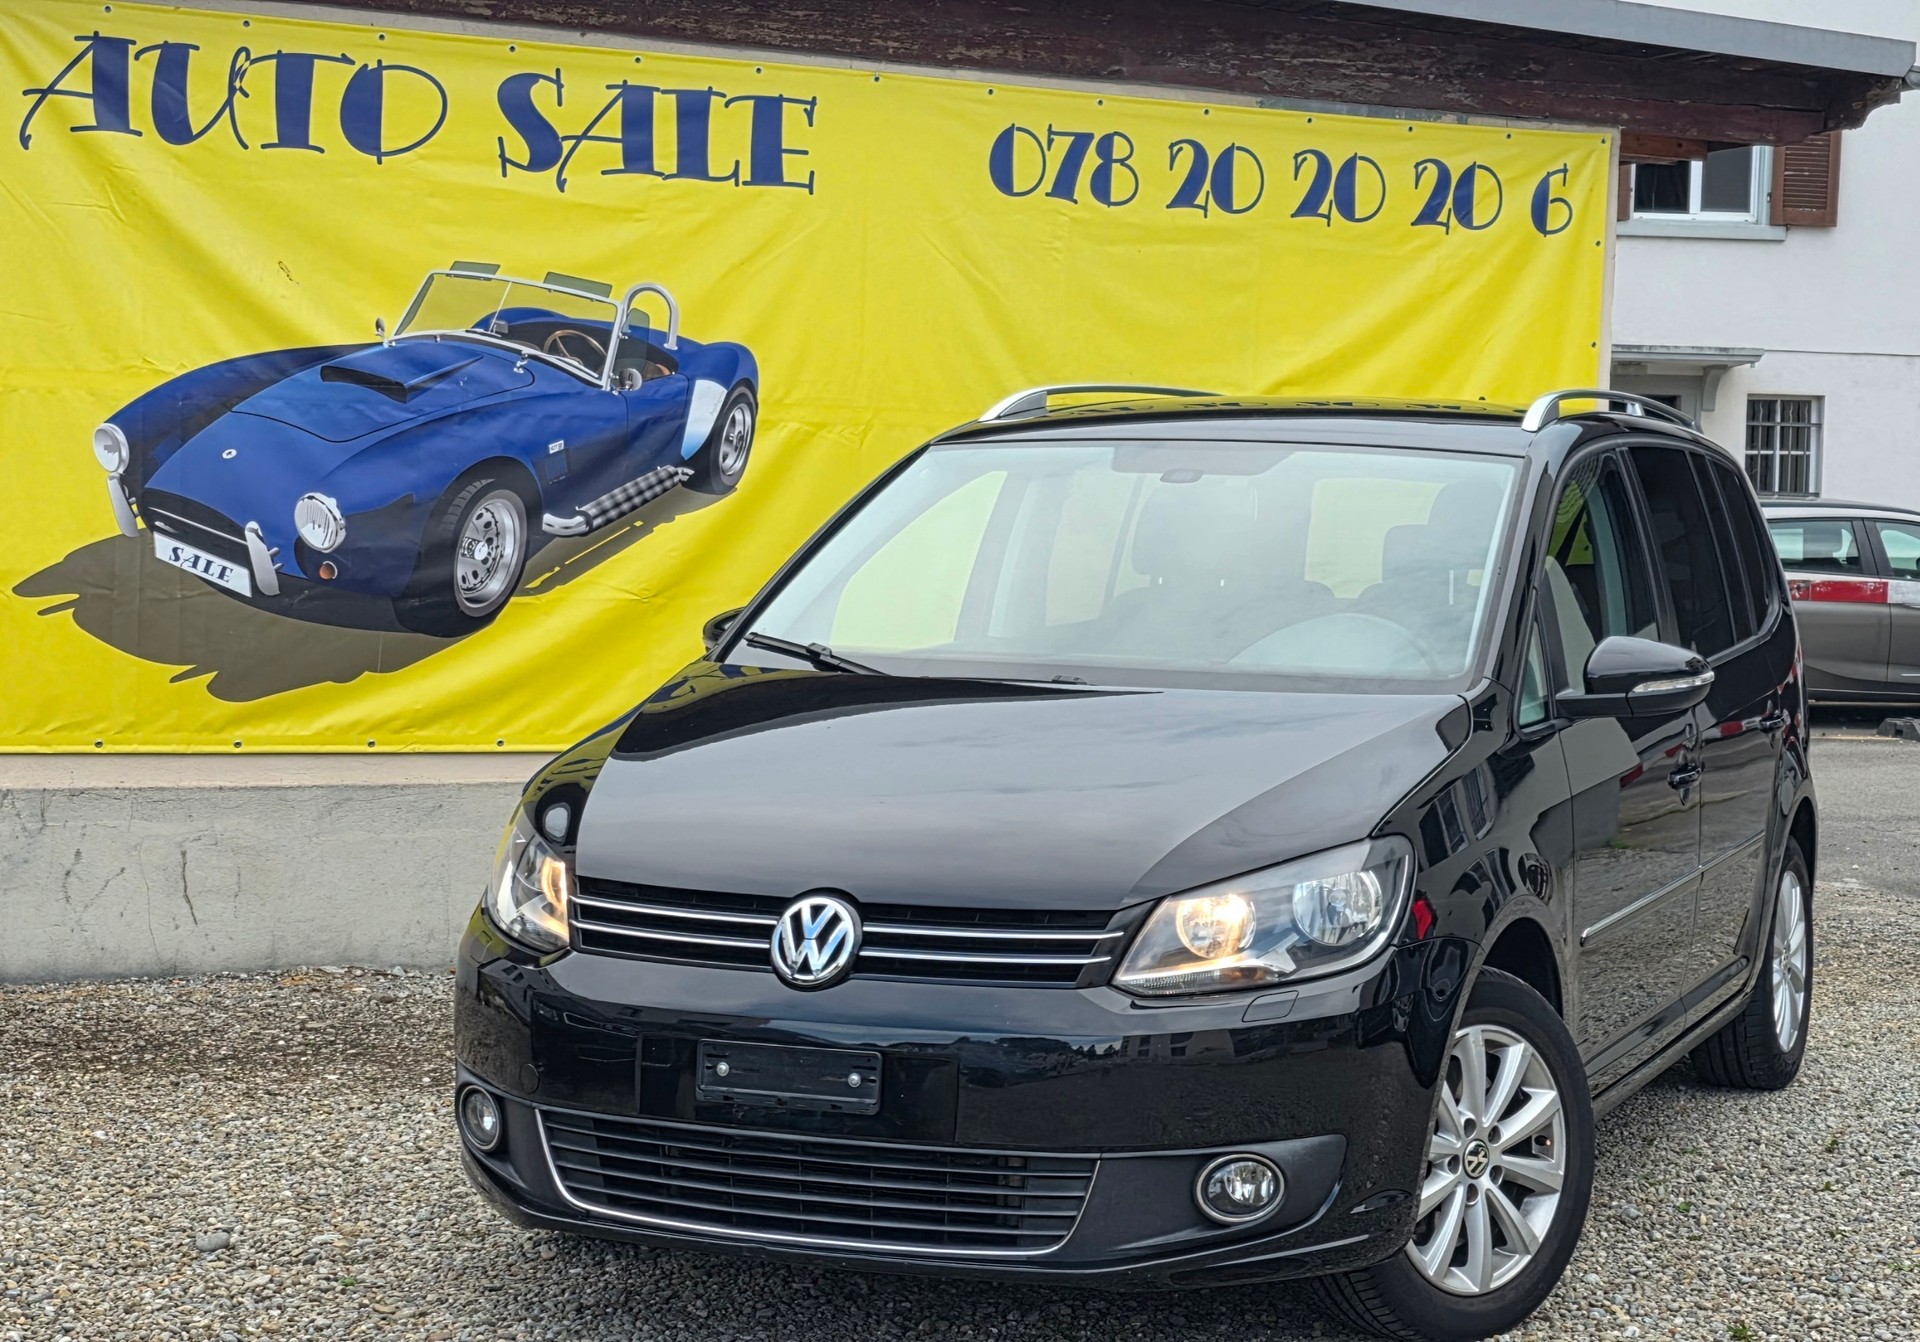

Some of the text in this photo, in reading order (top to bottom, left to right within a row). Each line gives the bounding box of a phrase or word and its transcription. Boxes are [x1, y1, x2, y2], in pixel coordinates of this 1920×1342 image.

[20, 31, 818, 194] AUTO SALE
[989, 123, 1574, 238] 078 20 20 20 6
[168, 546, 234, 583] SALE
[771, 896, 862, 985] VW
